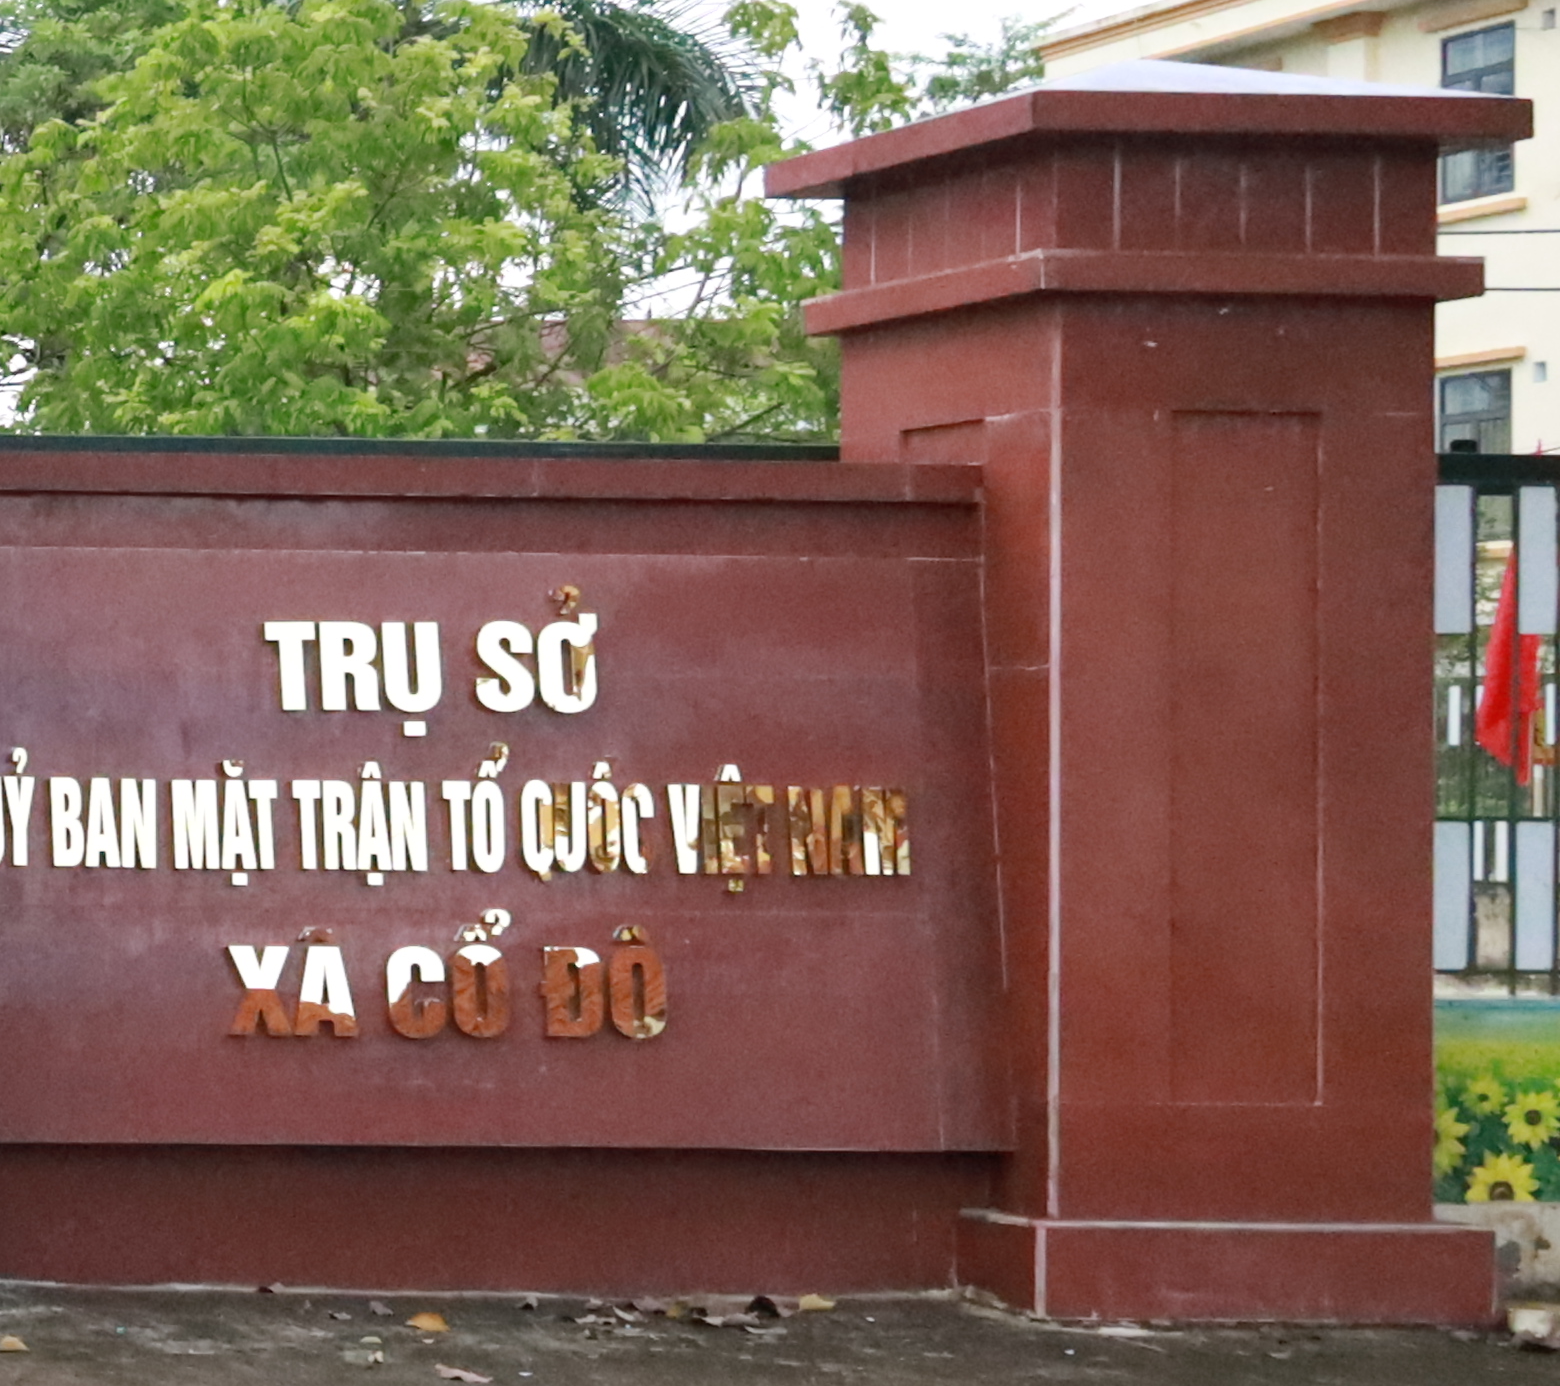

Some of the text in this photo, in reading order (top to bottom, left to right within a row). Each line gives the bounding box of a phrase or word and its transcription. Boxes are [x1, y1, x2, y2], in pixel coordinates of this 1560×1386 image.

[263, 585, 597, 736] TRỤ SỞ
[49, 775, 156, 869] BAN
[170, 758, 277, 885] MẶT
[290, 760, 428, 885] TRẬN
[440, 740, 507, 873] TỔ
[227, 908, 668, 1038] XÃ CỔ ĐÔ
